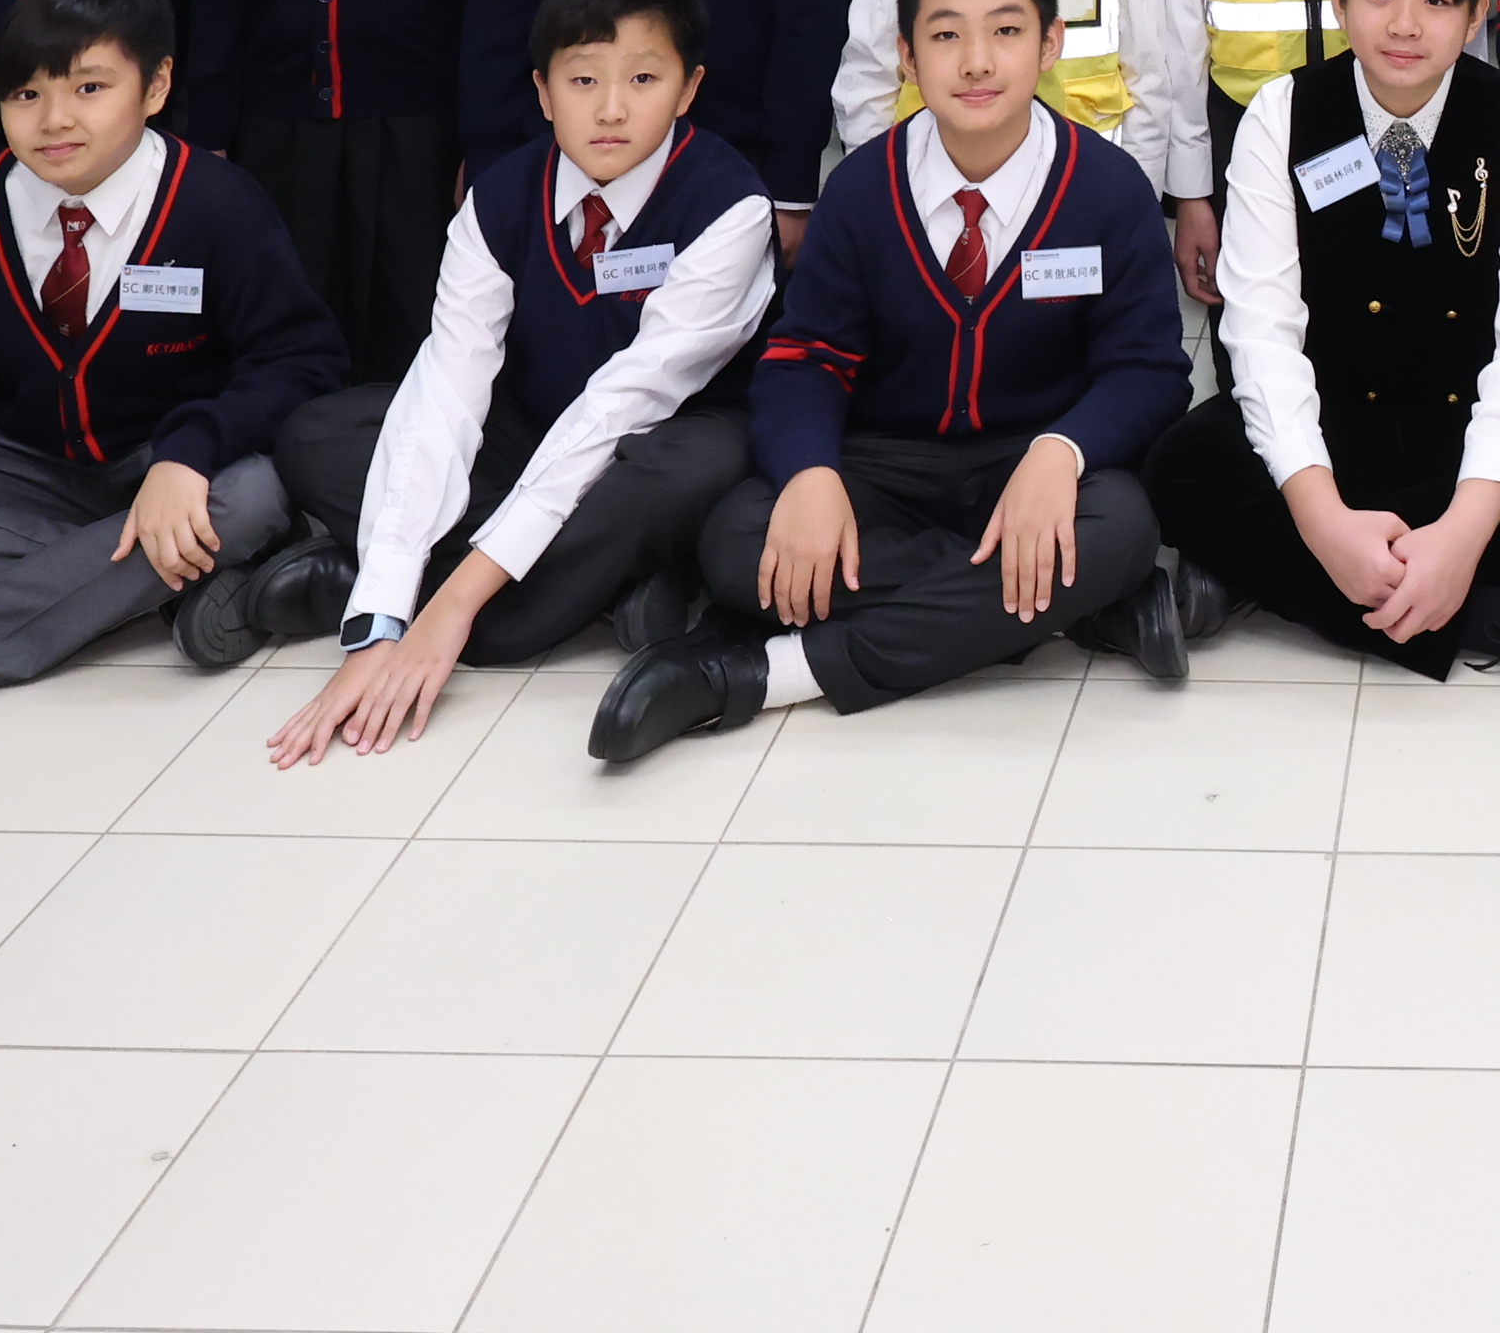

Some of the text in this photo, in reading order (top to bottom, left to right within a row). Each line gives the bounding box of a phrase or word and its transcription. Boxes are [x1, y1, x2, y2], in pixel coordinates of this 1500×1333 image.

[602, 268, 619, 280] 6C
[1024, 269, 1040, 281] 6C
[122, 283, 139, 294] 5C
